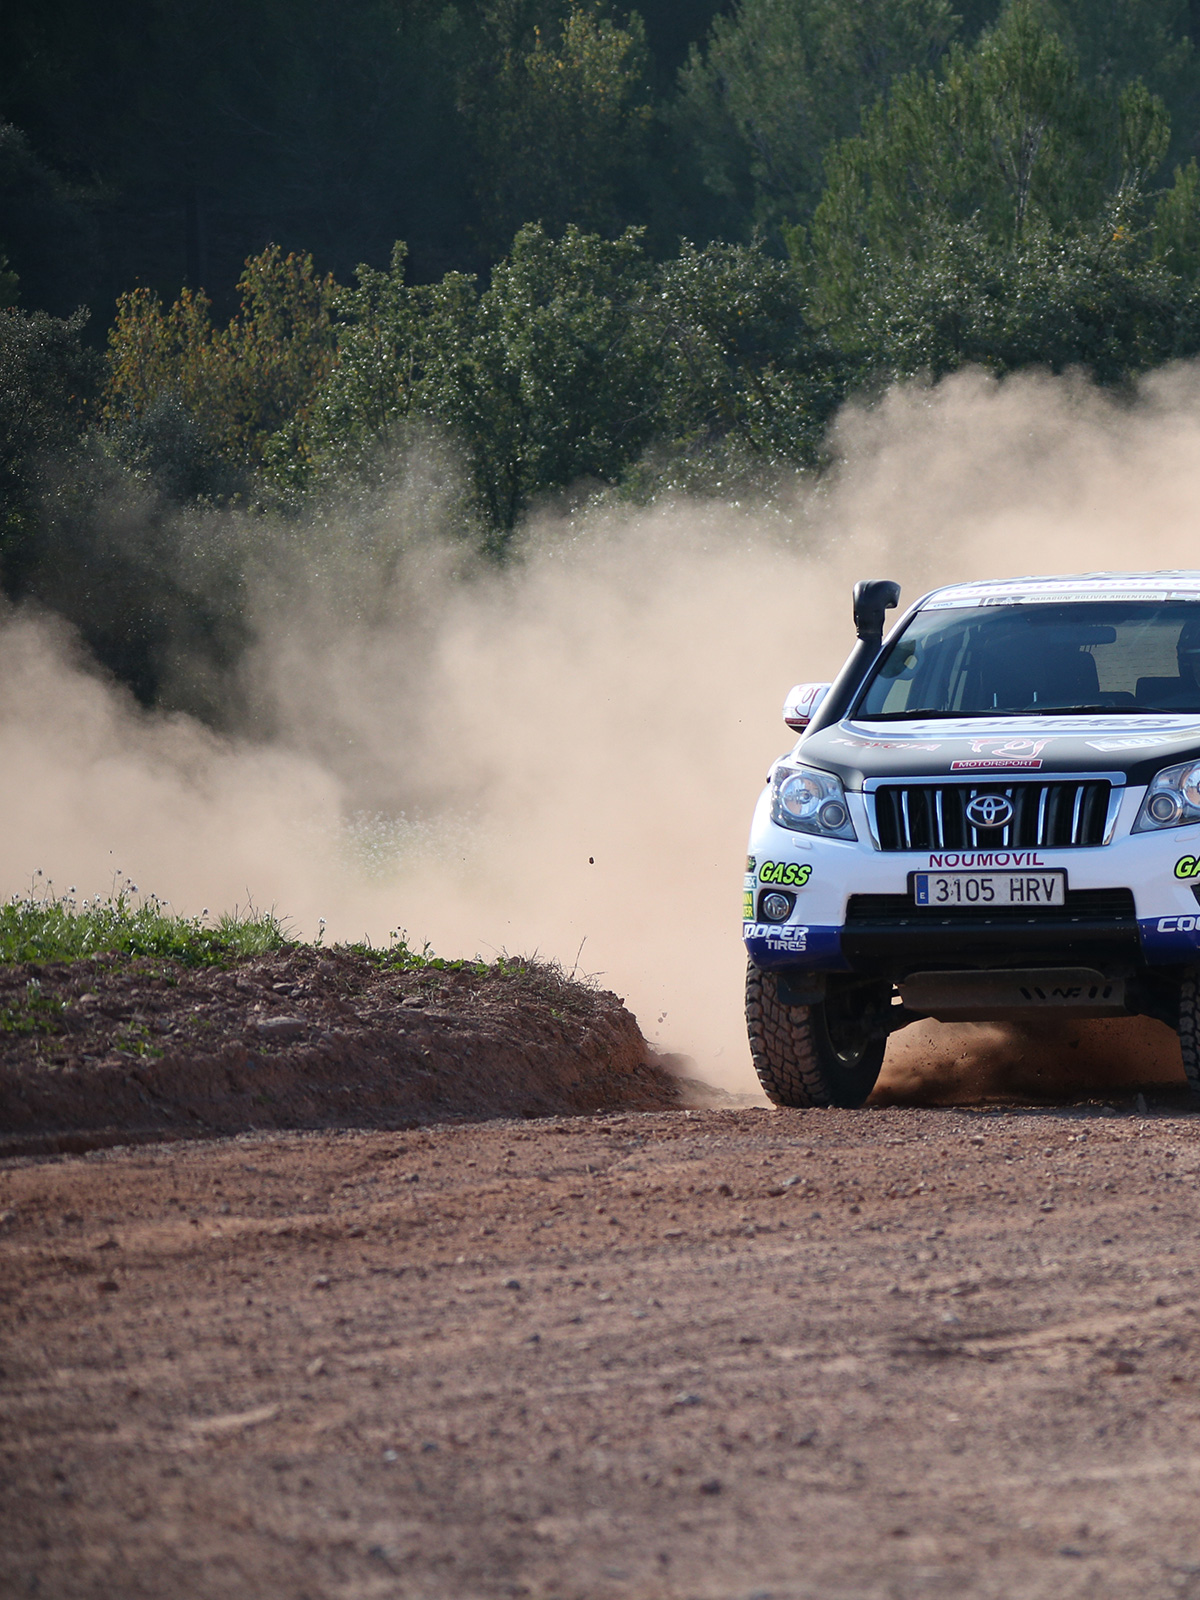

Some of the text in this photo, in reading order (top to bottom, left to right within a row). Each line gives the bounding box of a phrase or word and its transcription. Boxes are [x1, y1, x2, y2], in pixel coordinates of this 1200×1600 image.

[958, 760, 1035, 768] MOTORSPORT
[929, 853, 1044, 868] NOUMOVIL
[759, 861, 812, 886] GASS
[919, 891, 926, 899] E
[935, 878, 1056, 902] 3105 HRV
[765, 940, 807, 951] TIRES
